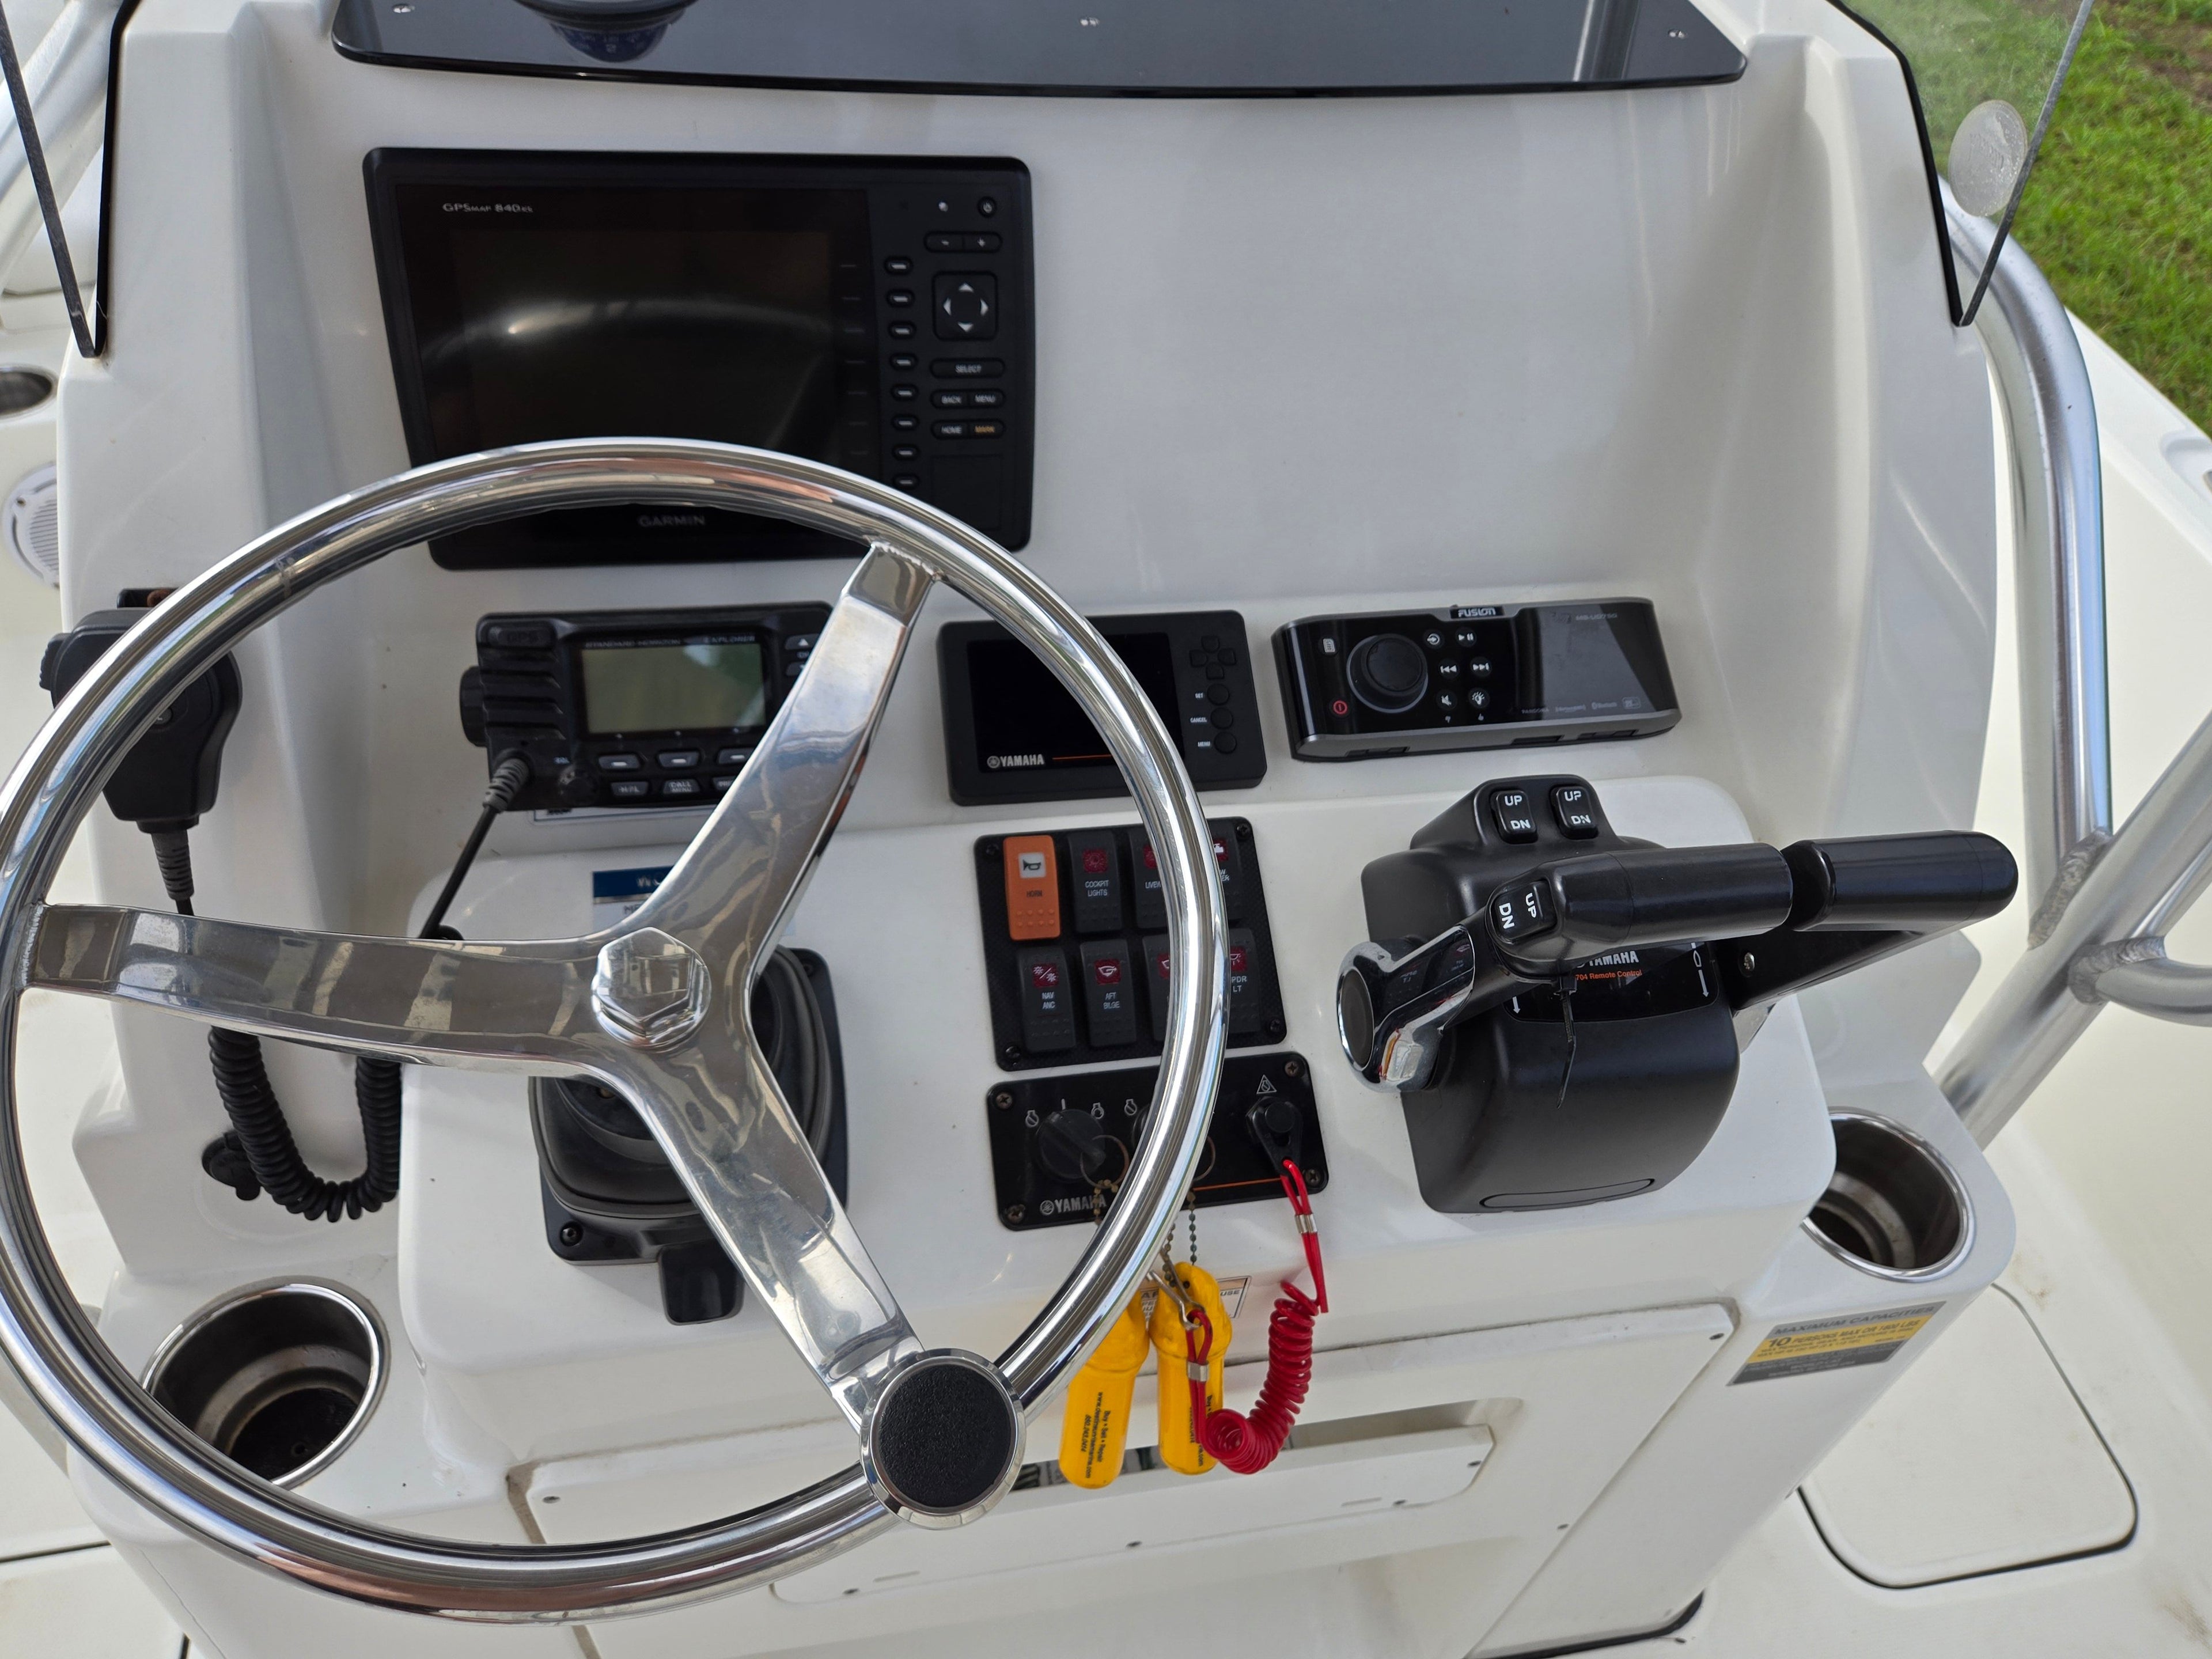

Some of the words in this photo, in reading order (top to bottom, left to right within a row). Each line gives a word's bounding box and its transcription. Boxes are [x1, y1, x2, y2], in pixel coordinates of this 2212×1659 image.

[956, 363, 982, 373] SELECT
[941, 395, 963, 404] BACK
[974, 394, 996, 403] MENU
[941, 425, 963, 434] HOME
[637, 514, 706, 527] GARMIN
[1457, 607, 1496, 618] FUSION
[999, 753, 1045, 767] YAMAHA
[1504, 794, 1522, 806] UP
[1563, 790, 1582, 802] UP
[1510, 819, 1531, 830] DN
[1570, 814, 1591, 825] DN
[1085, 880, 1109, 888] COCKPIT
[1026, 889, 1043, 897] HORN
[1088, 889, 1108, 897] LIGHTS
[1525, 892, 1537, 918] UP
[1499, 902, 1515, 929] DN
[1589, 972, 1616, 980] Remote
[1617, 969, 1642, 978] Control
[1233, 984, 1243, 993] LT
[1041, 991, 1055, 999] NAV
[1105, 991, 1117, 1000] AFT
[1042, 1001, 1056, 1009] ANC
[1103, 1001, 1120, 1009] BILGE
[1775, 1319, 1846, 1335] MAXIMUM
[1849, 1306, 1934, 1324] CAPACITIES
[1768, 1336, 1791, 1347] 10
[1102, 1411, 1111, 1422] Buy
[1100, 1427, 1108, 1438] Sell
[1097, 1444, 1106, 1462] Repair
